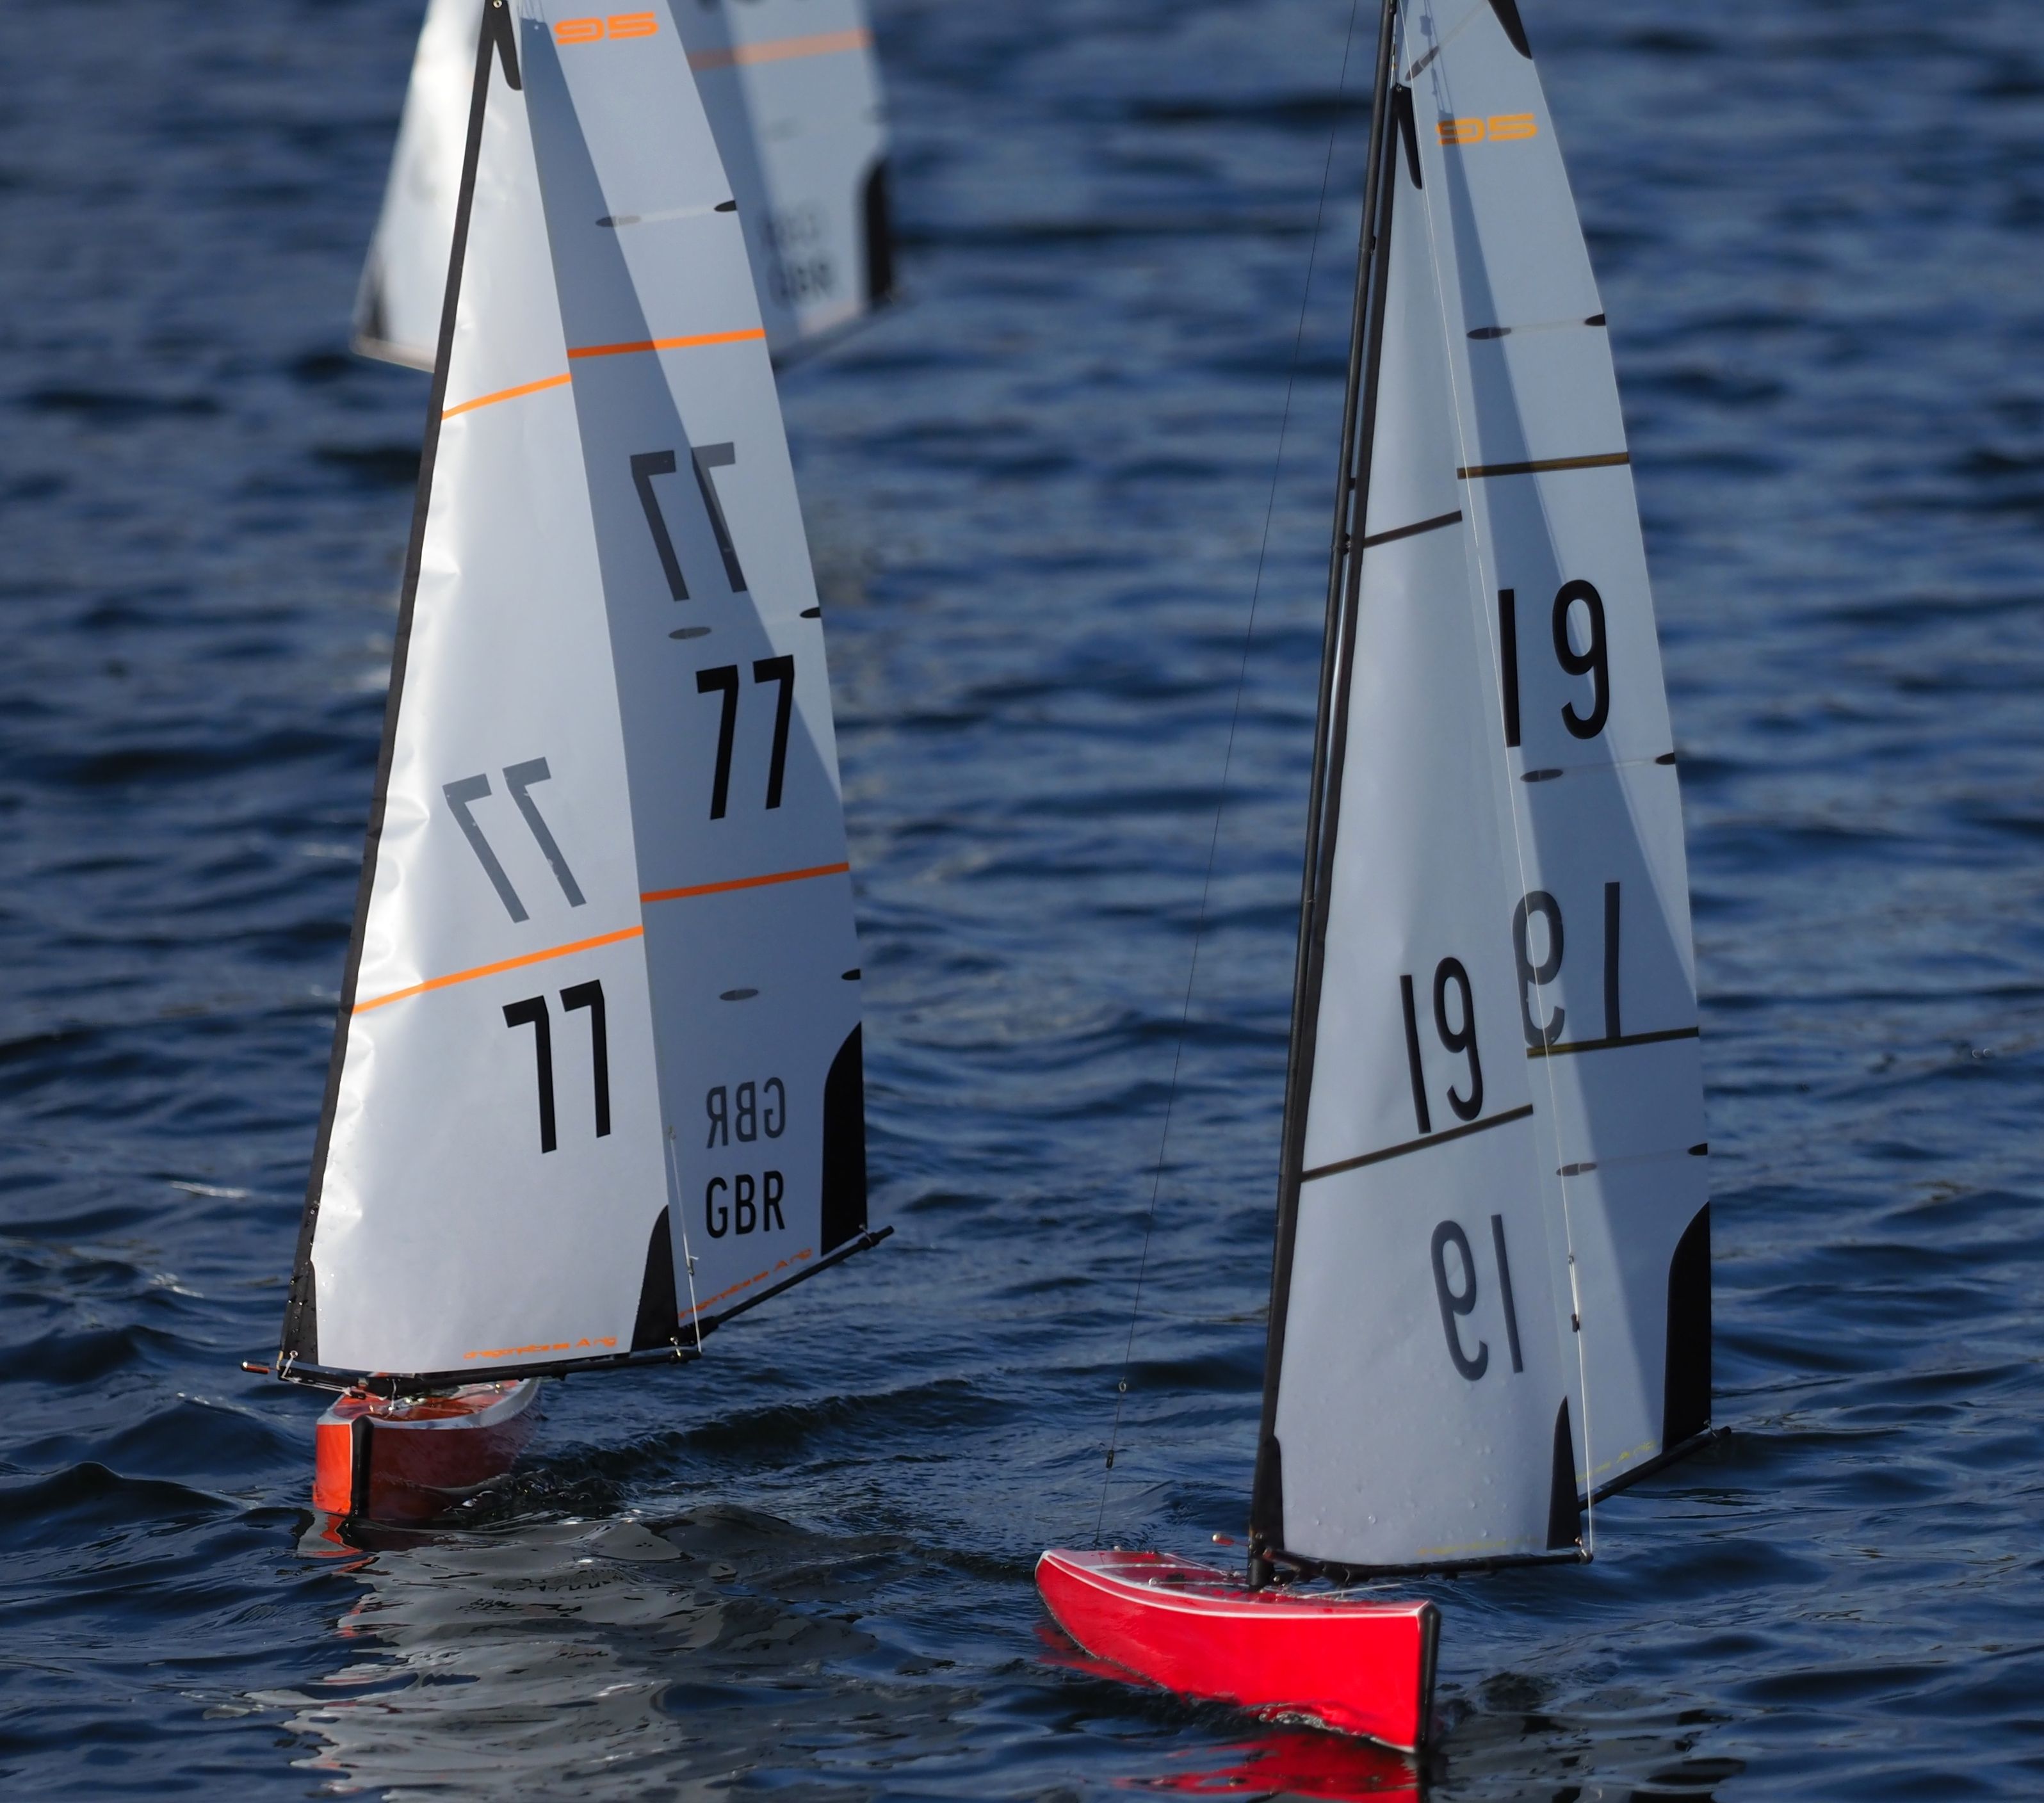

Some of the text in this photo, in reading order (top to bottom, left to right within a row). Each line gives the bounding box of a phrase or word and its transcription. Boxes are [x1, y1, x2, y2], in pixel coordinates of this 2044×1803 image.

[553, 12, 658, 45] 95
[1436, 113, 1537, 146] 95
[695, 654, 795, 820] 77
[1497, 579, 1610, 748] 19
[502, 980, 611, 1154] 77
[1400, 957, 1484, 1134] 19
[705, 1170, 786, 1239] GBR
